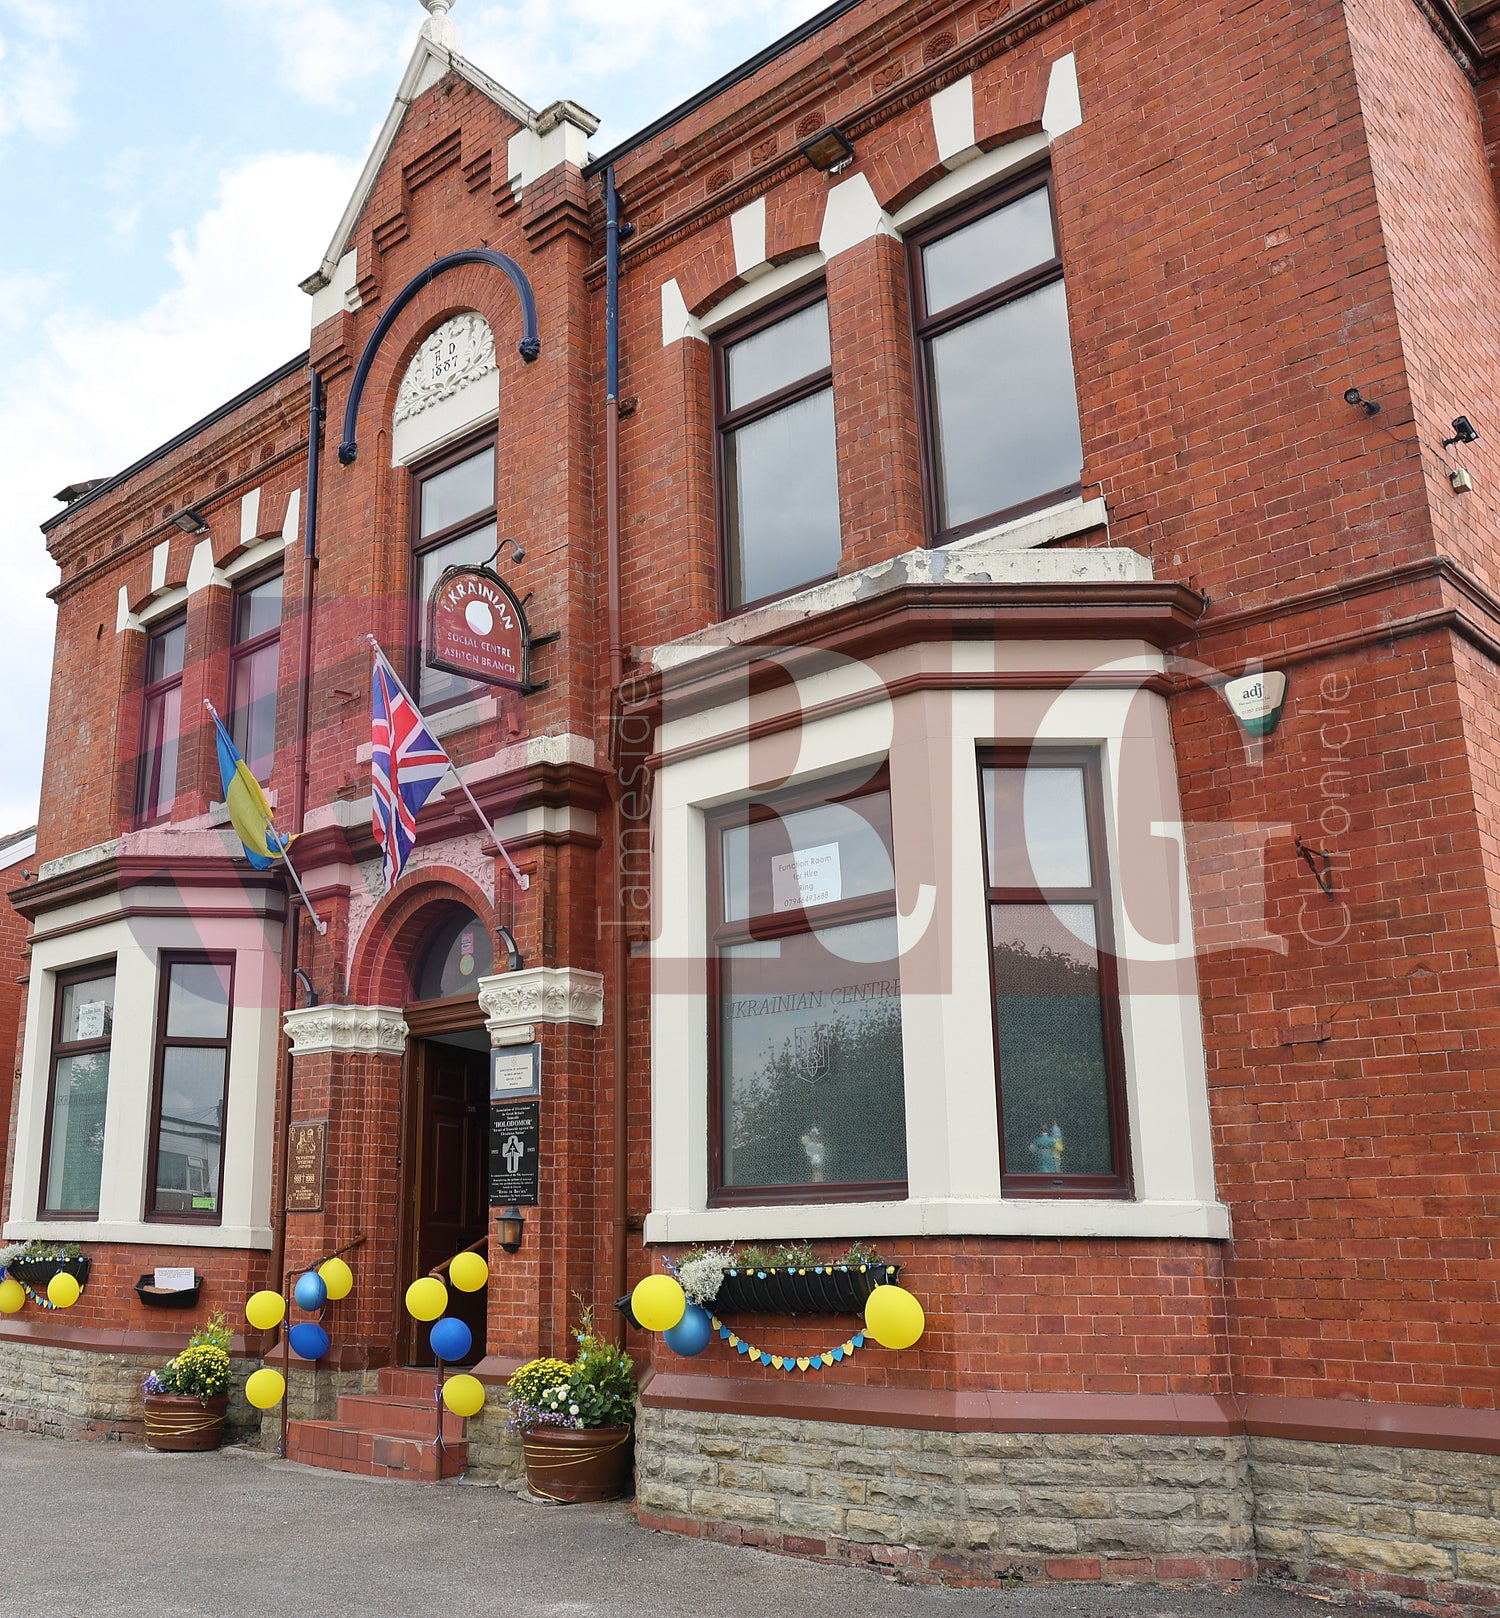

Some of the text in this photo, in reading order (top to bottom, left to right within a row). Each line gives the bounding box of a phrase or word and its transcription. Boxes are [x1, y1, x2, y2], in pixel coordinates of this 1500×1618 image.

[431, 354, 458, 380] 1887
[447, 631, 511, 658] SOCIAL CENTRE
[444, 647, 515, 674] ASHTON BRANCH
[804, 869, 818, 878] Hire
[810, 856, 831, 865] Room
